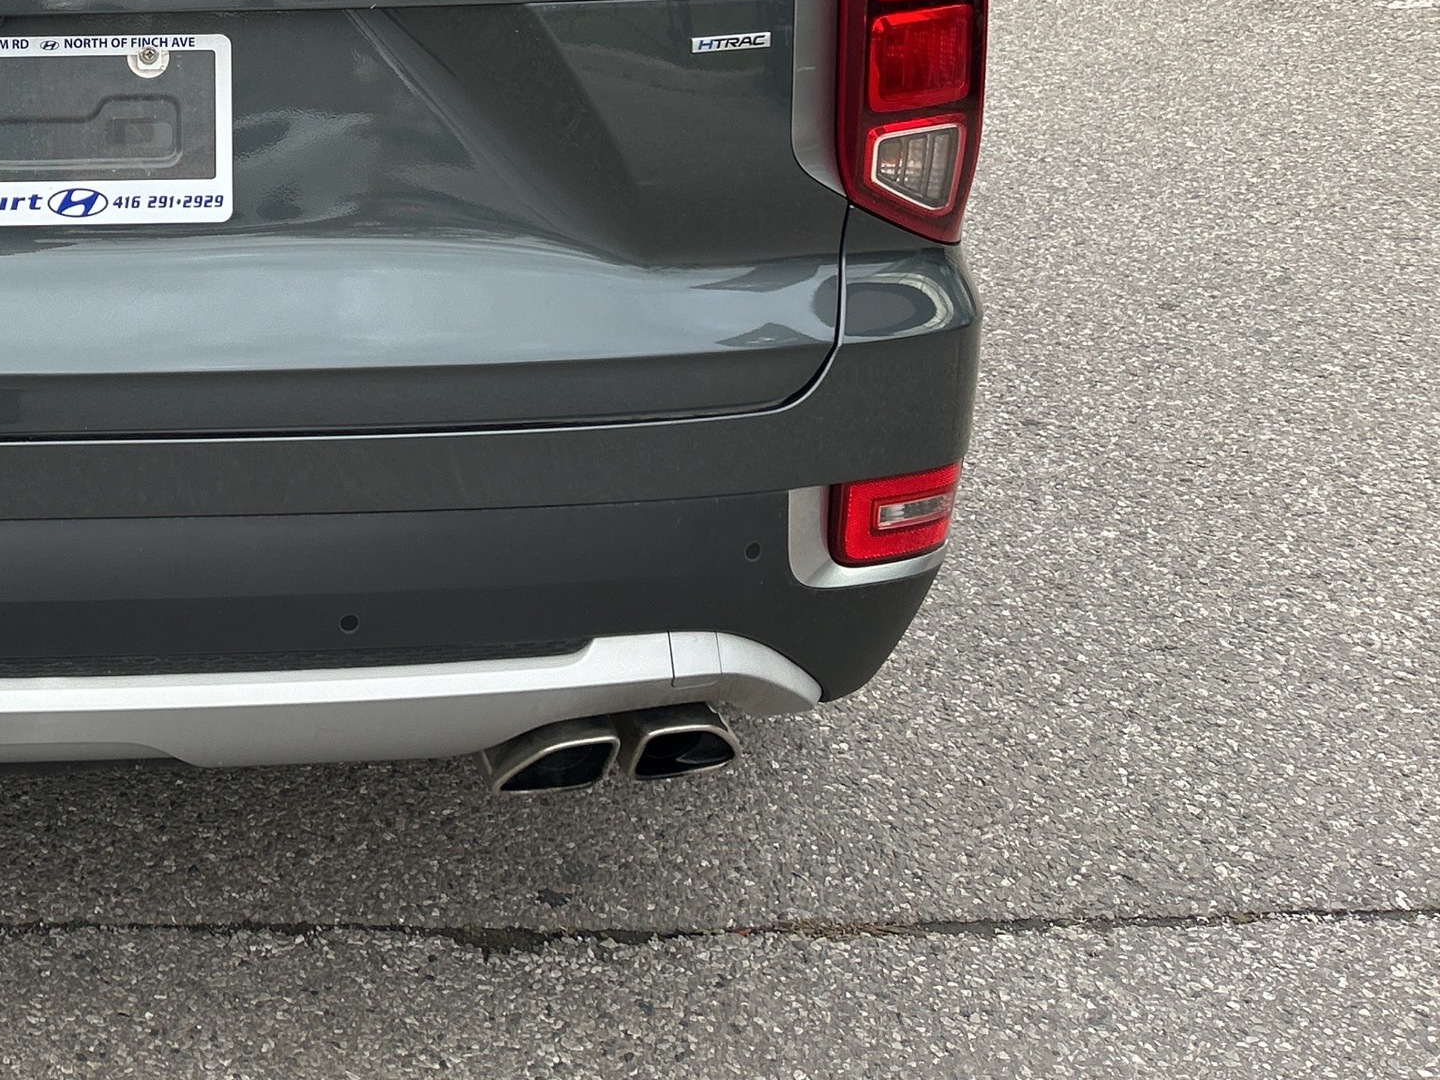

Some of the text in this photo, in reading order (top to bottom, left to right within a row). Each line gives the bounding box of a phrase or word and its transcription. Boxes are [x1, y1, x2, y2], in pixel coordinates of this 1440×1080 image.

[12, 38, 29, 49] RD
[64, 37, 195, 49] NORTH OF FINCH AVE
[698, 35, 766, 50] HTRAC
[112, 195, 142, 209] 416
